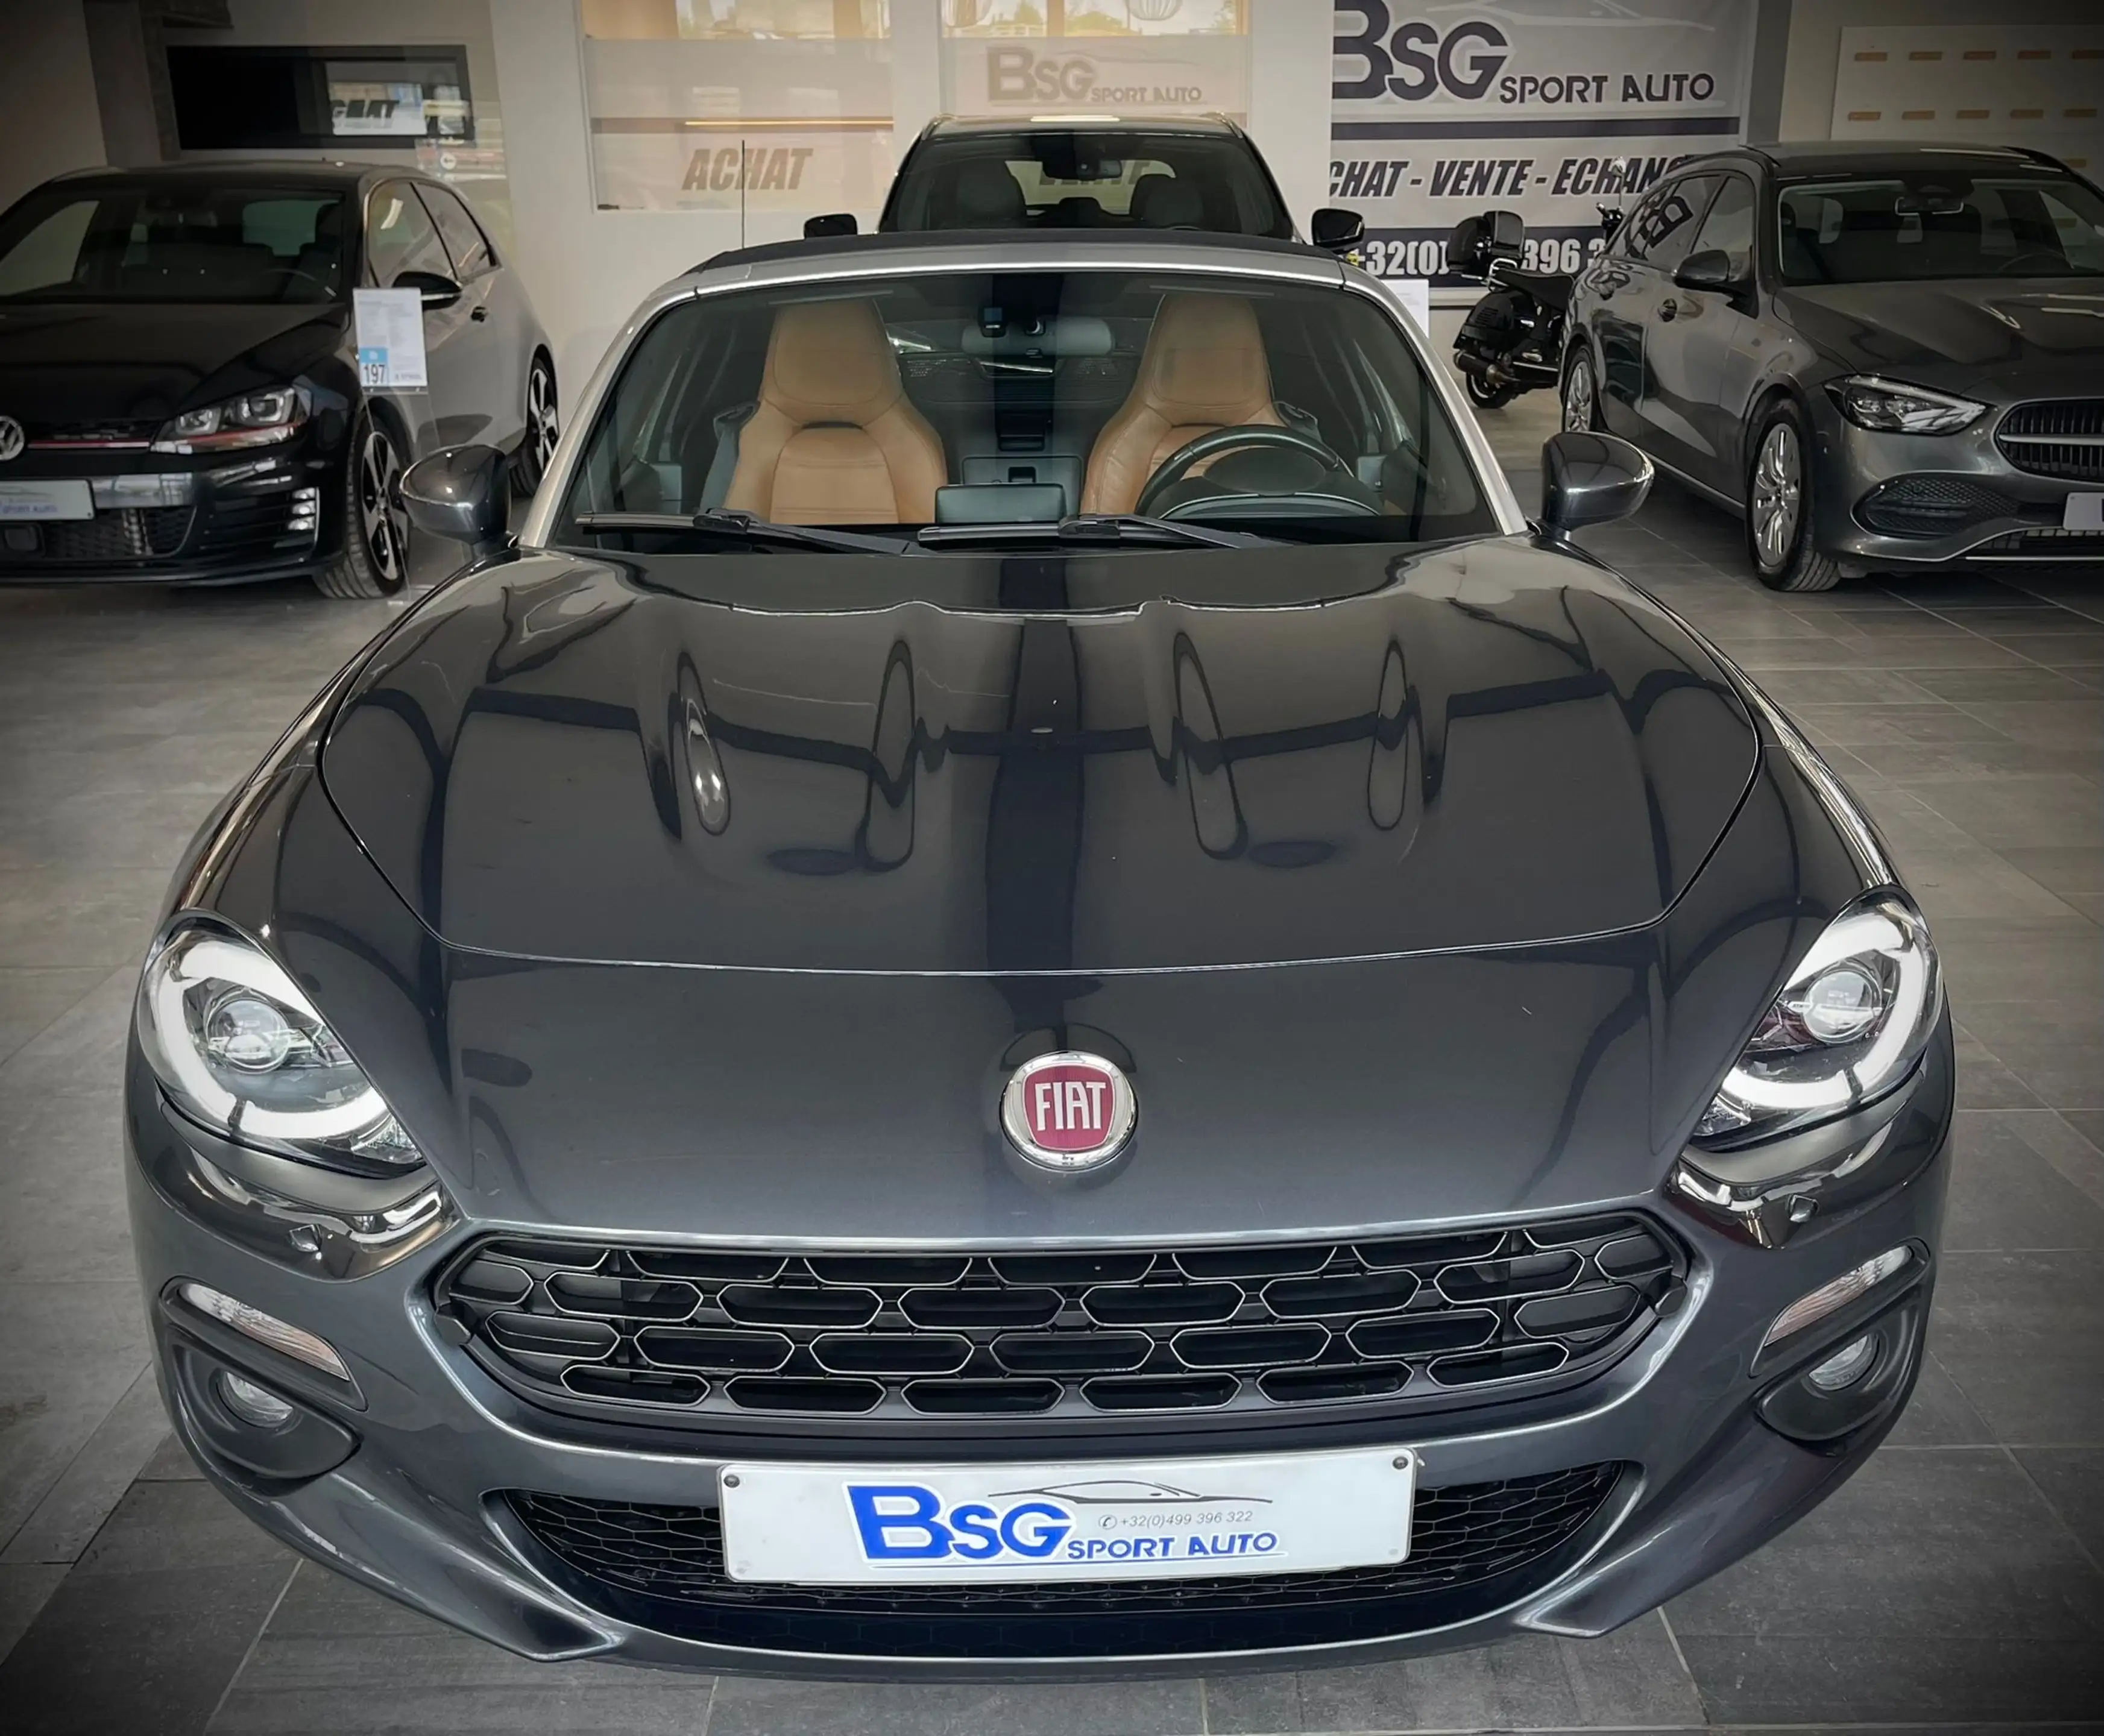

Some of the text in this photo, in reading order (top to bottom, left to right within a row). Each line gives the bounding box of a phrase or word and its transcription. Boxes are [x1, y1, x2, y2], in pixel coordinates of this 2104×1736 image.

[987, 46, 1202, 102] BSG SPORT AUTO
[1499, 75, 1608, 103] SPORT
[1622, 73, 1715, 102] AUTO
[681, 148, 814, 191] ACHAT
[1429, 159, 1534, 197] VENTE
[1522, 238, 1581, 274] 396
[364, 363, 385, 383] 197
[1035, 1081, 1106, 1131] FIAT
[847, 1485, 1277, 1560] BSG SPORT AUTO
[1121, 1510, 1253, 1529] +32(0)499 396 322
